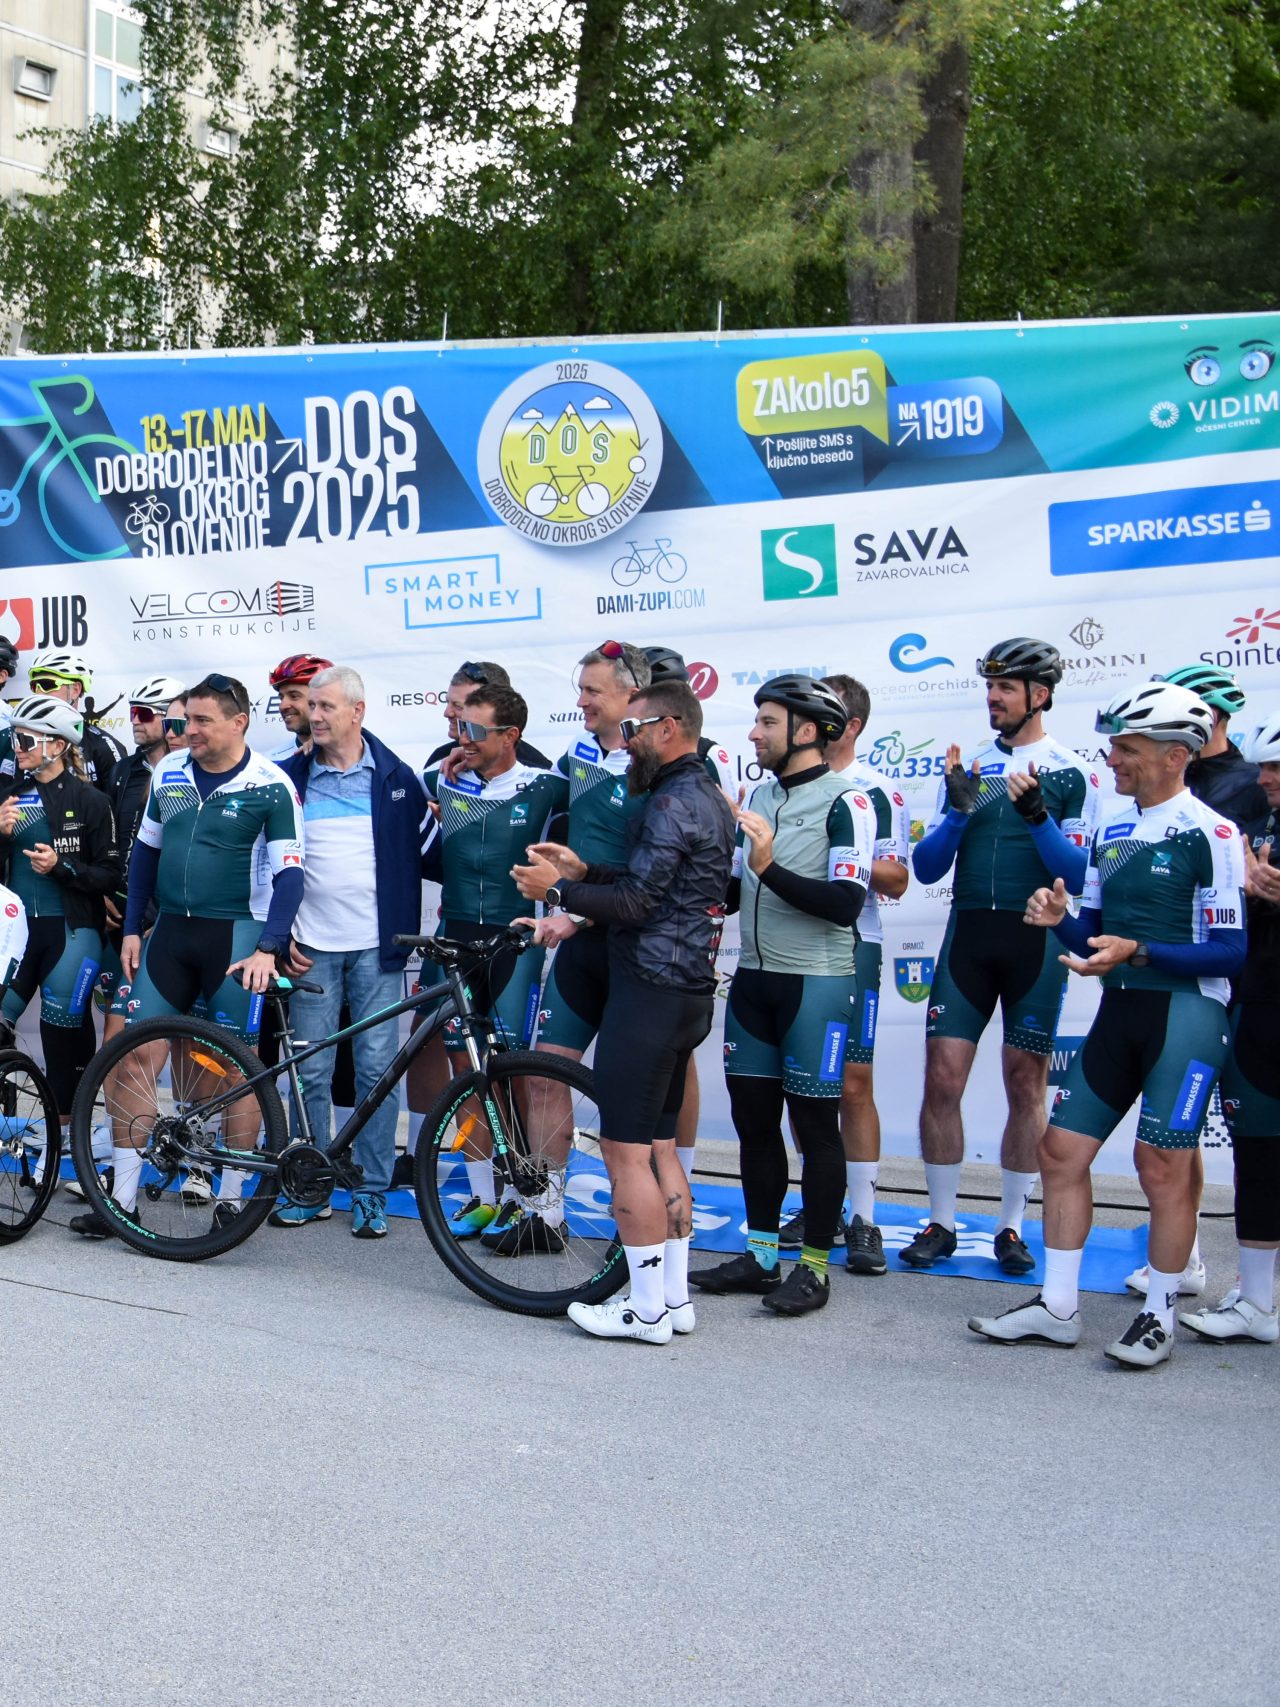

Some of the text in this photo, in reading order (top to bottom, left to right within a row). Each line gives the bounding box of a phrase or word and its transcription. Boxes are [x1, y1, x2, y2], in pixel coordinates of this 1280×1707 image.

[556, 363, 589, 381] 2025
[751, 367, 870, 417] ZAkolo5
[1189, 390, 1280, 422] VIDIM
[213, 403, 267, 446] MAJ
[304, 385, 418, 474] DOS
[898, 395, 984, 440] NA 1919
[1228, 418, 1261, 428] CENTER
[767, 447, 854, 470] ključno besedo
[777, 433, 853, 453] Pošljite SMS s
[95, 440, 268, 496] DOBRODELNO
[179, 478, 270, 524] OKROG
[283, 461, 420, 547] 2025
[485, 477, 652, 543] DOBRODELNO OKROG SLOVENIJE
[1087, 511, 1241, 547] SPARKASSE
[854, 525, 969, 566] SAVA
[385, 570, 480, 594] SMART
[856, 563, 970, 582] ZAVAROVALNICA
[130, 587, 262, 618] VELCOM
[425, 589, 520, 612] MONEY
[596, 588, 706, 615] DAMI-ZUPI.COM
[38, 594, 89, 650] JUB
[133, 618, 317, 641] KONSTRUKCIJE
[222, 809, 238, 818] SAVA
[1150, 865, 1170, 874] SAVA
[1214, 908, 1236, 924] JUB
[902, 941, 925, 951] ORMOŽ
[828, 1038, 840, 1073] SPARKASSE
[1182, 1080, 1201, 1121] SPARKASSE
[103, 1198, 157, 1240] ALUTERRA
